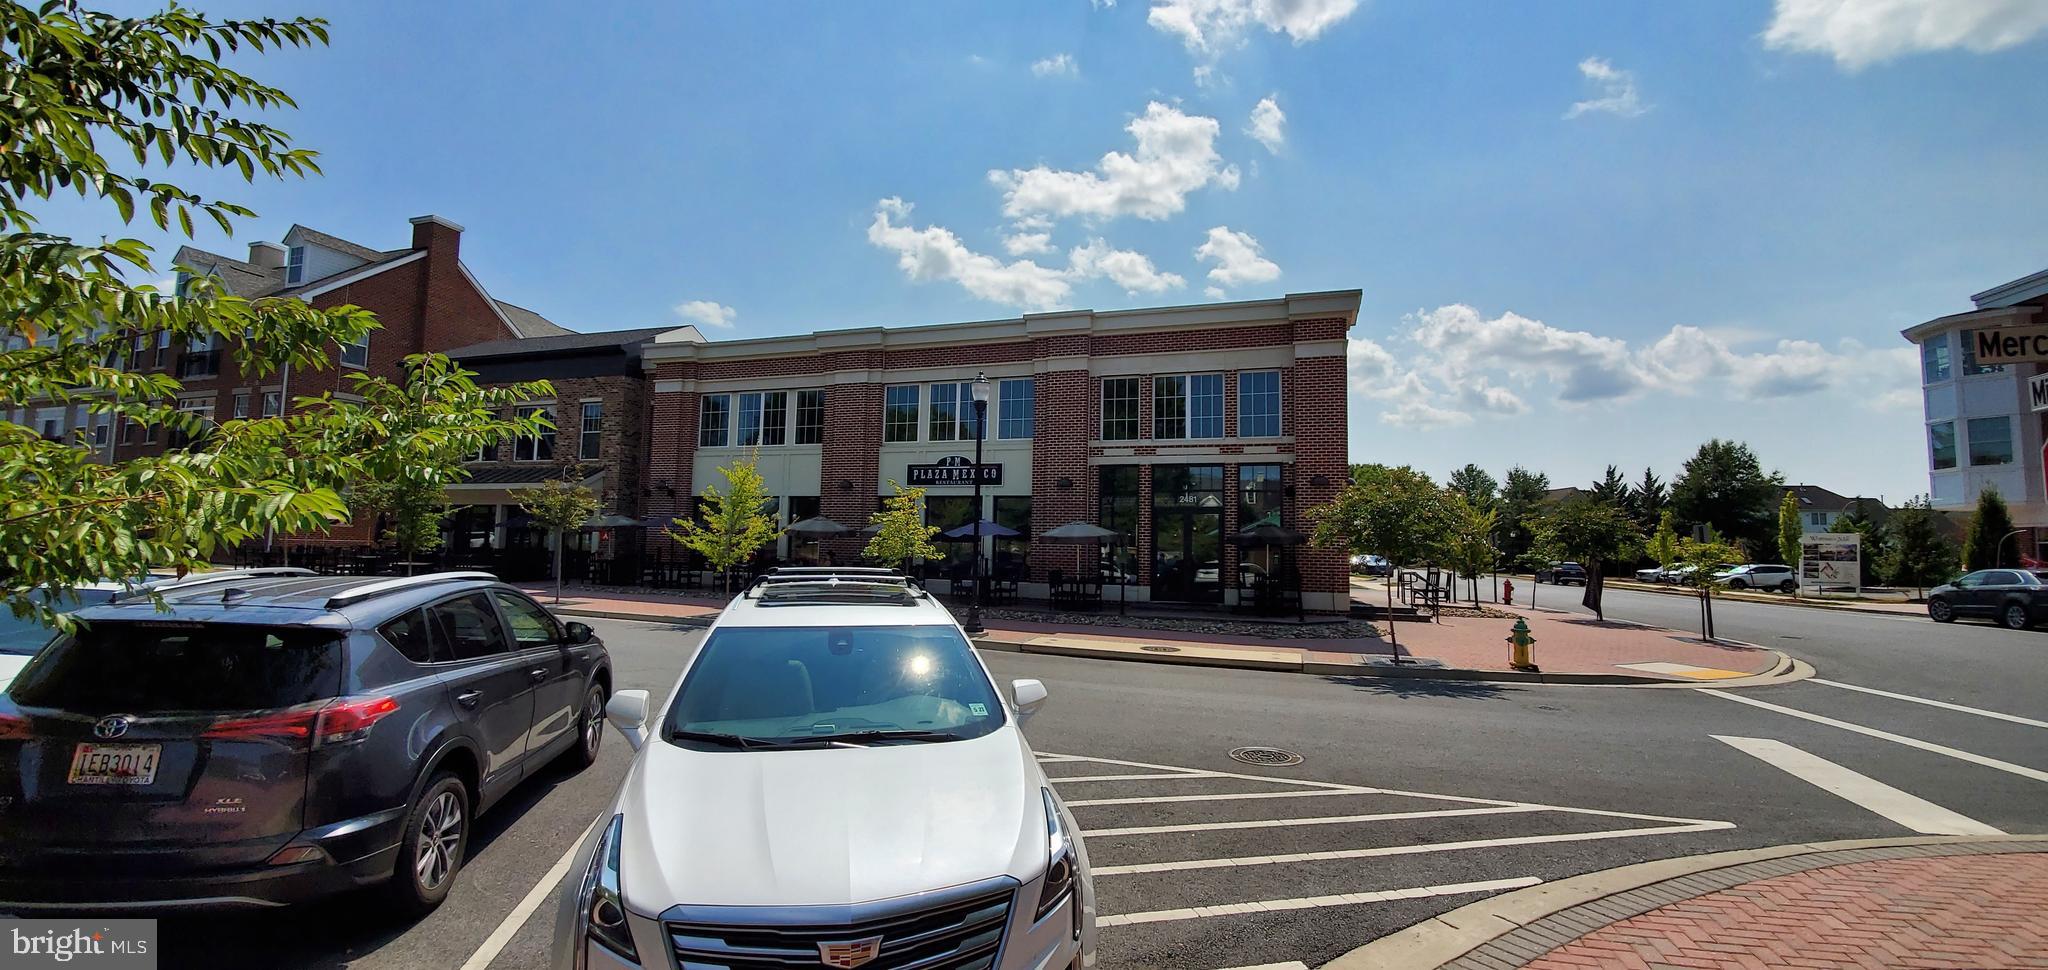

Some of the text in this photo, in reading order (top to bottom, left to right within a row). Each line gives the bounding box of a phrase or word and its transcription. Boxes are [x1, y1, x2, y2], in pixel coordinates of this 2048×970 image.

[1978, 331, 2048, 357] Merc
[913, 469, 997, 480] PLAZA MEXCO
